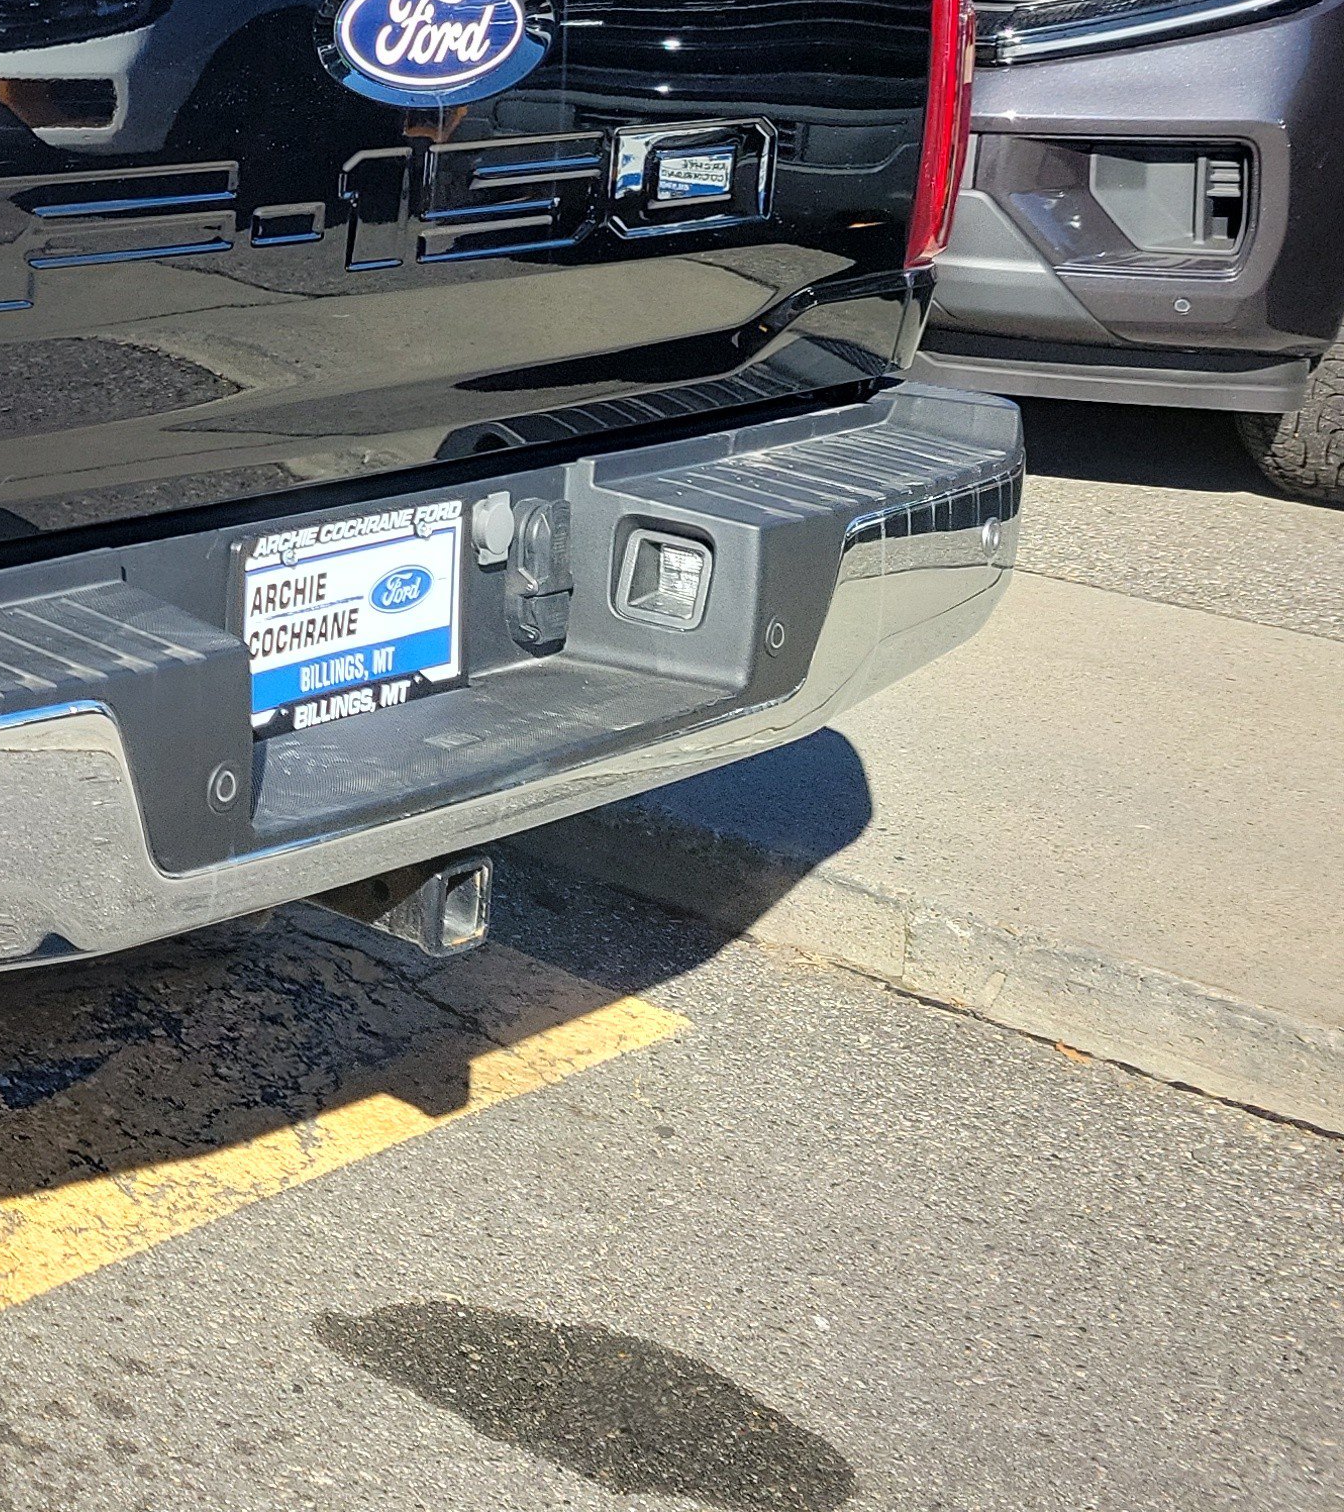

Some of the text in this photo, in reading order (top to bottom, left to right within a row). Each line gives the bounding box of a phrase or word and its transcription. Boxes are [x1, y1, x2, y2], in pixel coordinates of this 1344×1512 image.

[253, 499, 462, 559] ARCHIE COCHRANE FORD
[250, 572, 328, 618] ARCHIE
[381, 572, 422, 607] Ford
[248, 607, 360, 660] COCHRANE
[300, 646, 395, 693] BILLINGS, MT
[293, 679, 412, 730] BILLINGS, MT
